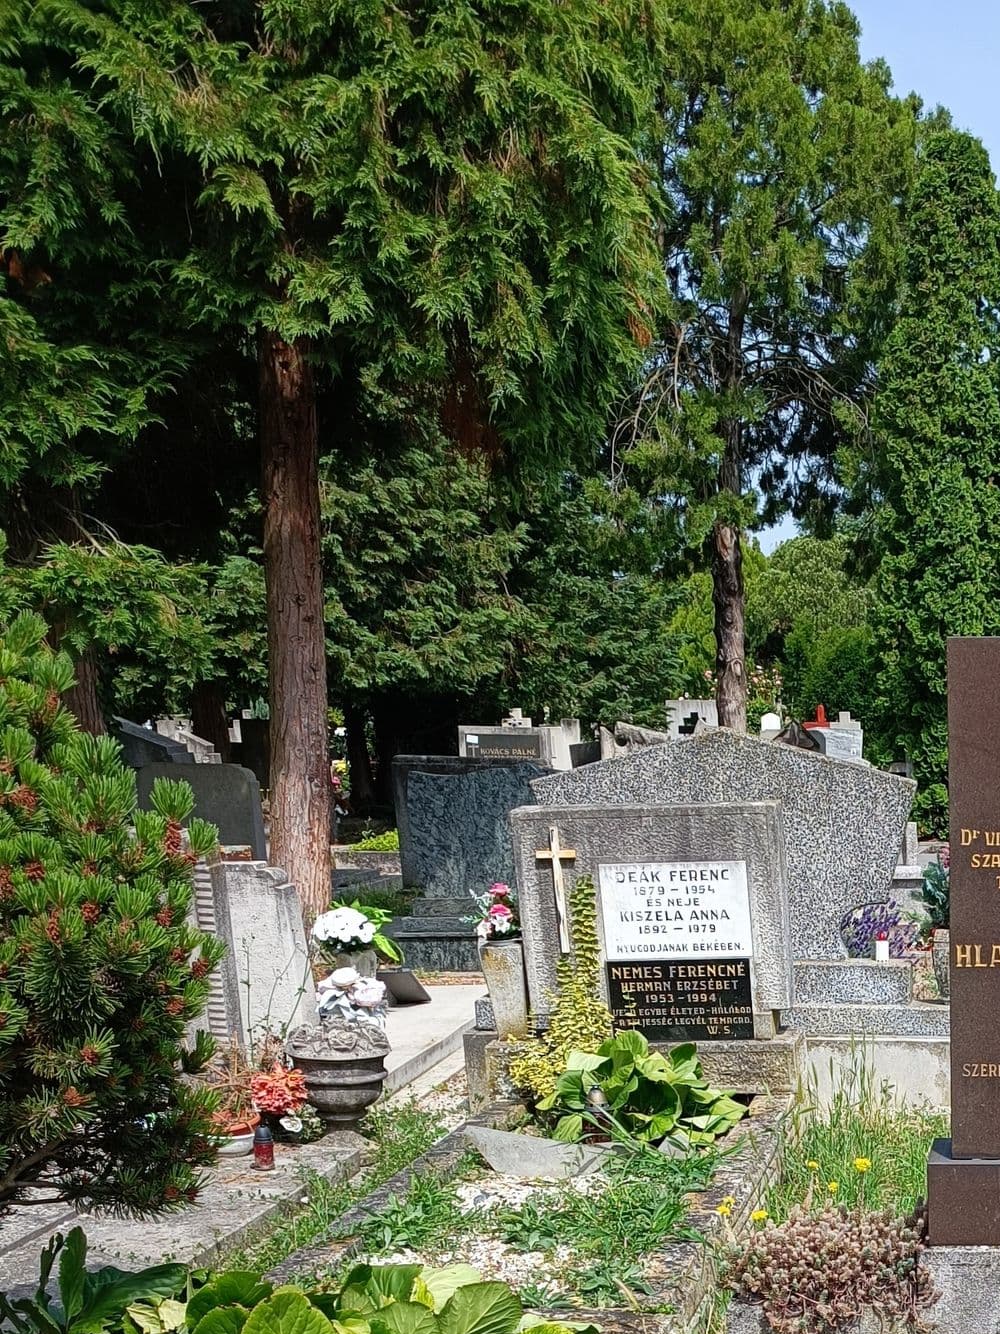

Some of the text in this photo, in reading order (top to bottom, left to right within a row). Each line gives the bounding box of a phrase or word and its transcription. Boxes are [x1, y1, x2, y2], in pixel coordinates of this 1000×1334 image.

[616, 866, 730, 884] DEÁK FERENC
[633, 885, 665, 896] 1879
[685, 884, 715, 895] 1954
[620, 909, 730, 922] KISZELA ANNA
[638, 925, 668, 934] 1892
[688, 924, 716, 933] 1979
[611, 961, 746, 980] NEMES FERENCNÉ
[620, 978, 739, 993] HERMAN ERZSÉBET
[645, 995, 674, 1003] 1953
[639, 1008, 668, 1017] EGYBE
[675, 1015, 707, 1025] LEGYÉL
